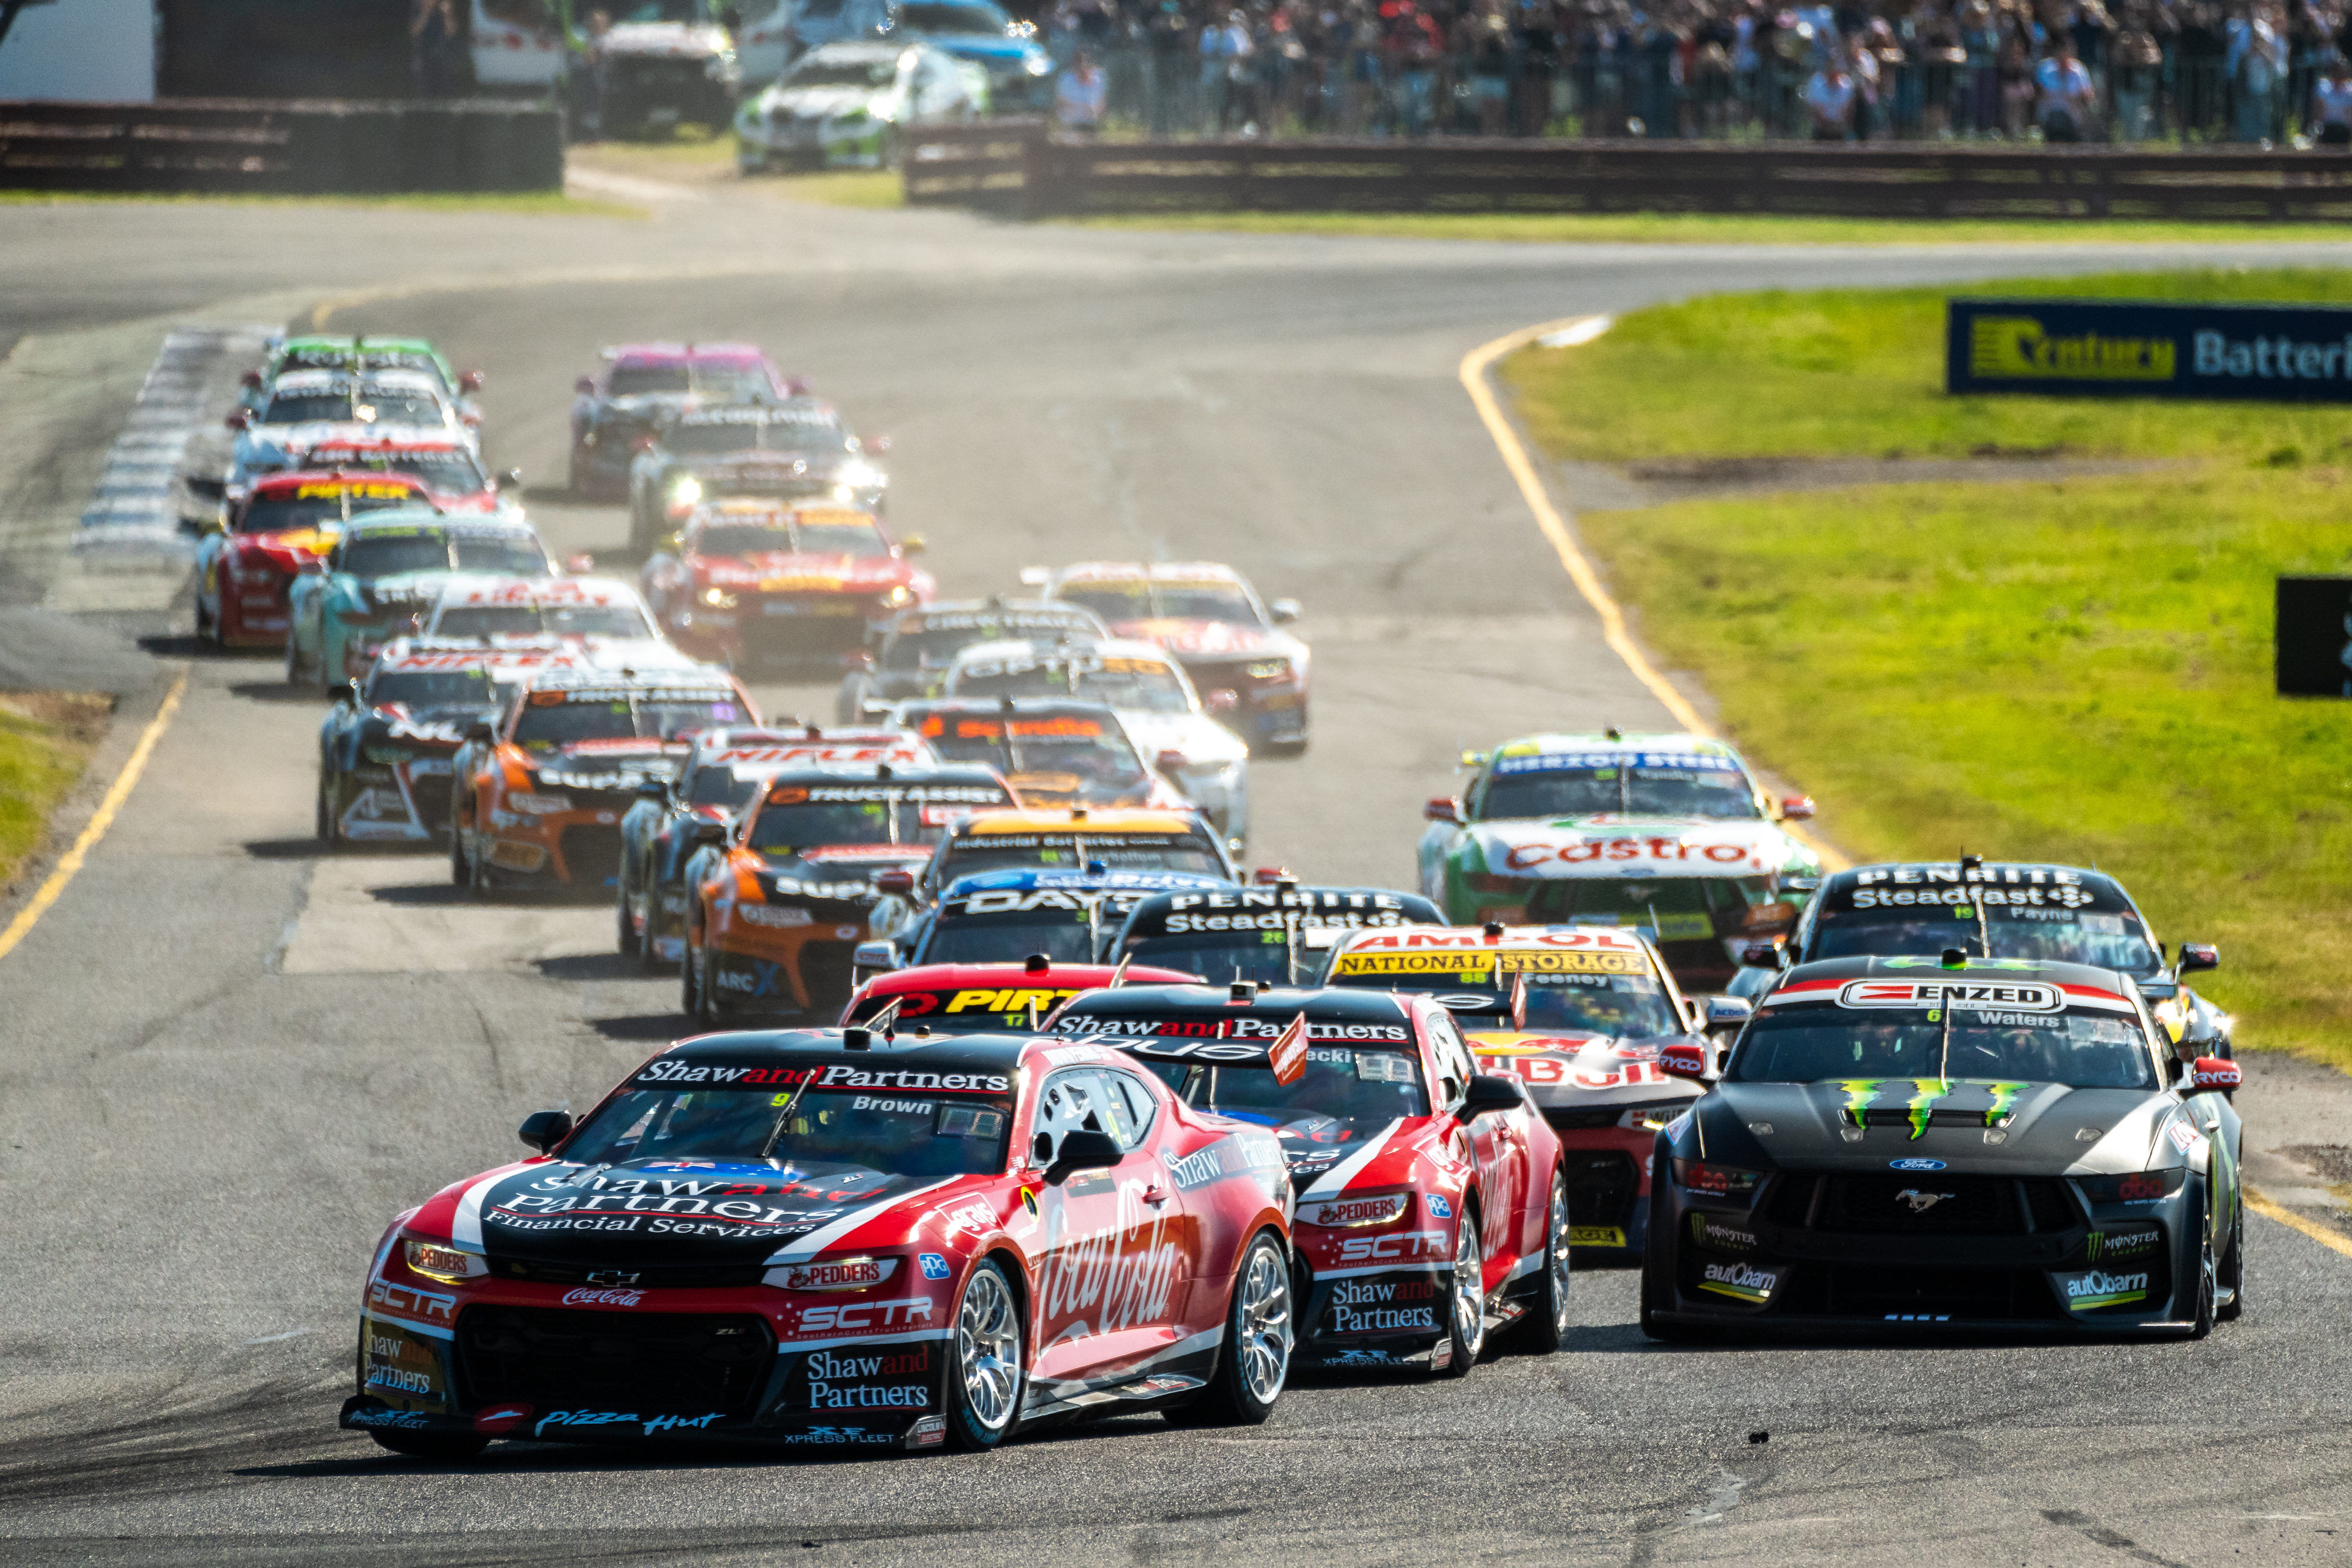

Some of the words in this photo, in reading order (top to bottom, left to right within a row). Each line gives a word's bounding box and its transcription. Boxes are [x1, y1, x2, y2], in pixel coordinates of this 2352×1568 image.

[808, 787, 904, 802] TRUCK
[907, 787, 1003, 803] ASSIST
[1044, 837, 1125, 847] Bateries
[1856, 868, 2083, 885] PENRITE
[1170, 891, 1402, 910] PENRITE
[1852, 885, 2046, 908] Steadfast
[1165, 911, 1363, 933] Steadfast
[1954, 906, 1975, 920] 19
[2010, 907, 2074, 921] Payne
[1354, 934, 1637, 951] AMPOL
[1341, 952, 1486, 974] NATIONAL
[1501, 952, 1645, 973] STORAGE
[1523, 972, 1608, 987] Feeney
[945, 989, 1081, 1014] PIRT
[1916, 986, 2043, 1003] ENZED
[1003, 1015, 1027, 1027] 17
[1927, 1009, 1942, 1022] 6
[1977, 1011, 2060, 1028] Waters
[1231, 1019, 1408, 1041] Patners
[1659, 1055, 1701, 1071] RYCO
[637, 1061, 751, 1083] Shaw
[818, 1065, 1010, 1092] Partners
[2193, 1070, 2241, 1085] RYCO
[771, 1093, 790, 1107] 9
[852, 1095, 933, 1115] Brown
[1900, 1159, 1935, 1169] Ford
[497, 1192, 845, 1225] Partners
[1338, 1198, 1397, 1221] PEDDERS
[1428, 1193, 1450, 1216] PPG
[482, 1211, 637, 1232] Financial
[648, 1218, 817, 1238] Services
[1340, 1230, 1448, 1261] SCTR
[420, 1247, 468, 1274] PEDDERS
[923, 1256, 948, 1277] PPG
[809, 1262, 881, 1285] PEDDERS
[562, 1286, 649, 1308] Coca-Cola
[1332, 1279, 1397, 1305] Shaw
[1396, 1271, 1434, 1300] and
[798, 1296, 933, 1332] SCTR
[1334, 1306, 1434, 1332] Partners
[364, 1353, 431, 1394] Partners
[807, 1351, 884, 1380] Shaw
[883, 1345, 928, 1375] and
[808, 1381, 930, 1409] Partners
[642, 1412, 727, 1436] Hut
[784, 1435, 846, 1445] XPRESS
[850, 1434, 896, 1443] FLEET
